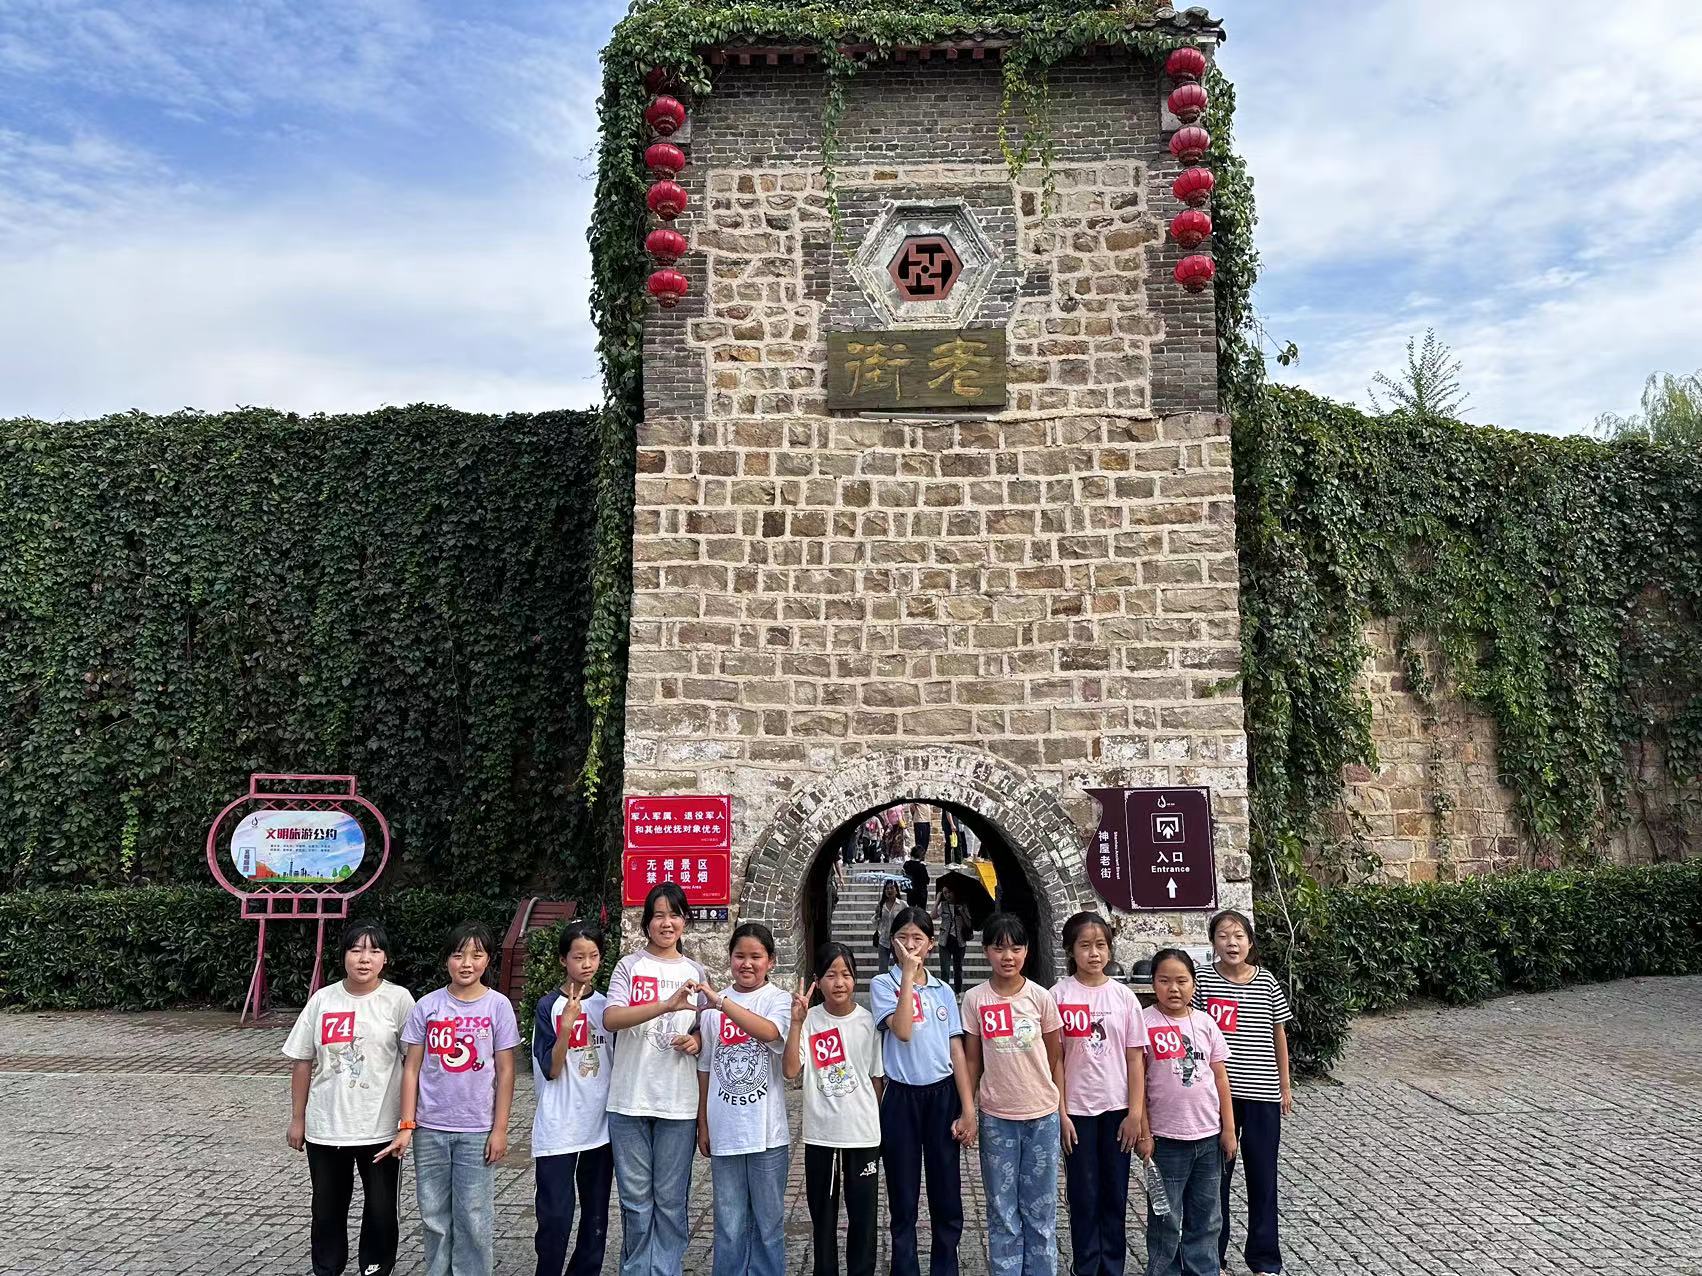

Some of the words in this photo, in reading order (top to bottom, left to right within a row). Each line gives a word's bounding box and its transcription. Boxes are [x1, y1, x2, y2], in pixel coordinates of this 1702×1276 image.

[265, 828, 338, 840] 文明旅游公约
[635, 825, 721, 834] 和其他优抚对象优先
[646, 859, 708, 871] 无烟景区
[1156, 851, 1183, 863] 入口
[646, 871, 708, 884] 禁止吸烟
[1151, 865, 1191, 873] Entrance
[632, 981, 656, 1002] 65
[444, 1016, 491, 1028] OTSO
[984, 1008, 1010, 1032] 81
[1063, 1009, 1089, 1031] 90
[1210, 1003, 1235, 1026] 97
[325, 1017, 352, 1038] 74
[429, 1026, 453, 1049] 66
[815, 1035, 842, 1061] 82
[1154, 1031, 1180, 1054] 89
